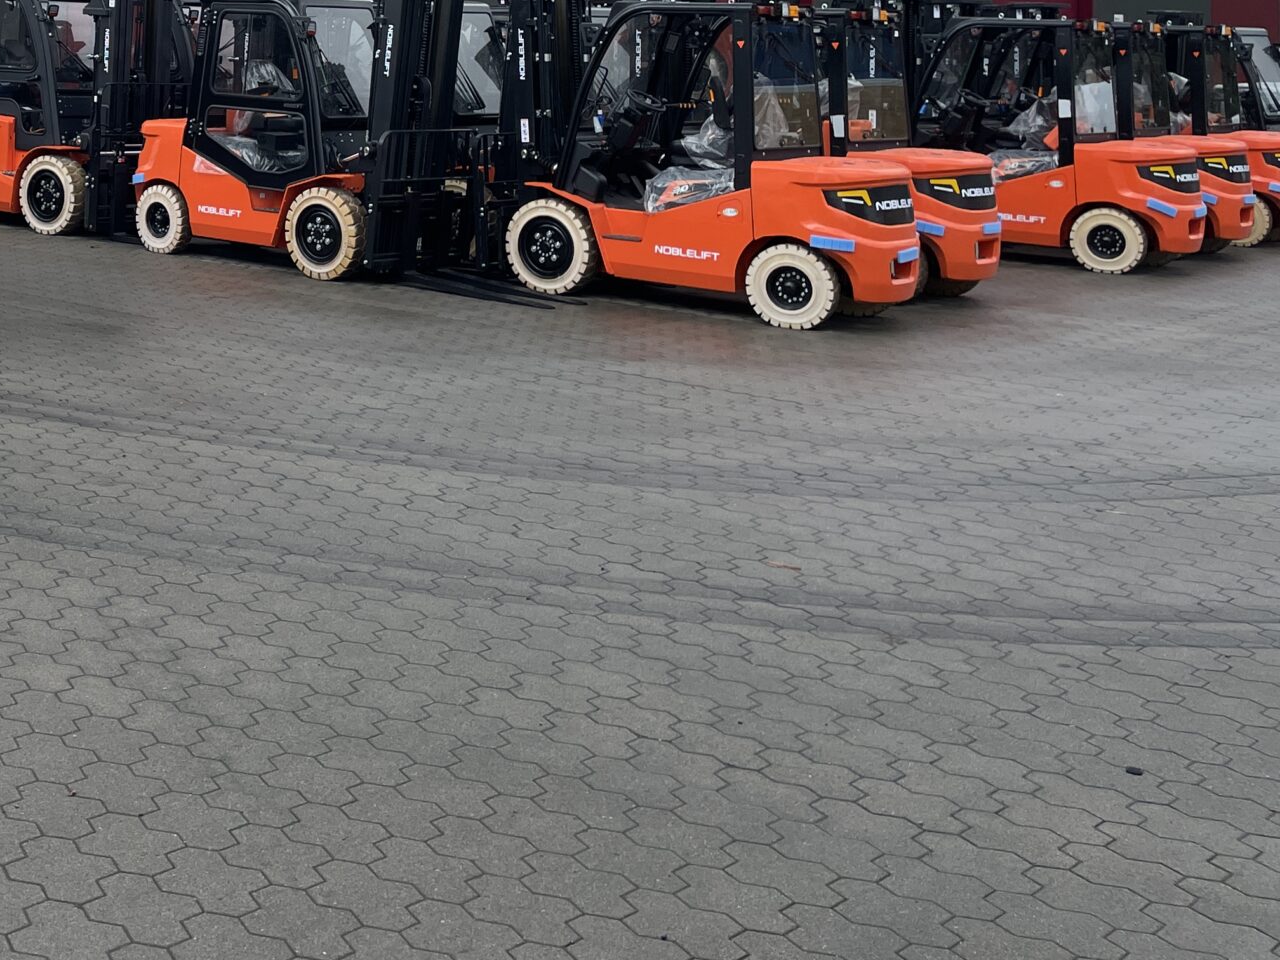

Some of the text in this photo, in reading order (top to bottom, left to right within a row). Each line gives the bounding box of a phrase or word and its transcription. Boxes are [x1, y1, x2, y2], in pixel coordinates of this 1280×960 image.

[383, 24, 394, 78] NOBLELIFT
[198, 205, 242, 218] NOBLELIFT
[654, 244, 720, 262] NOBLELIFT
